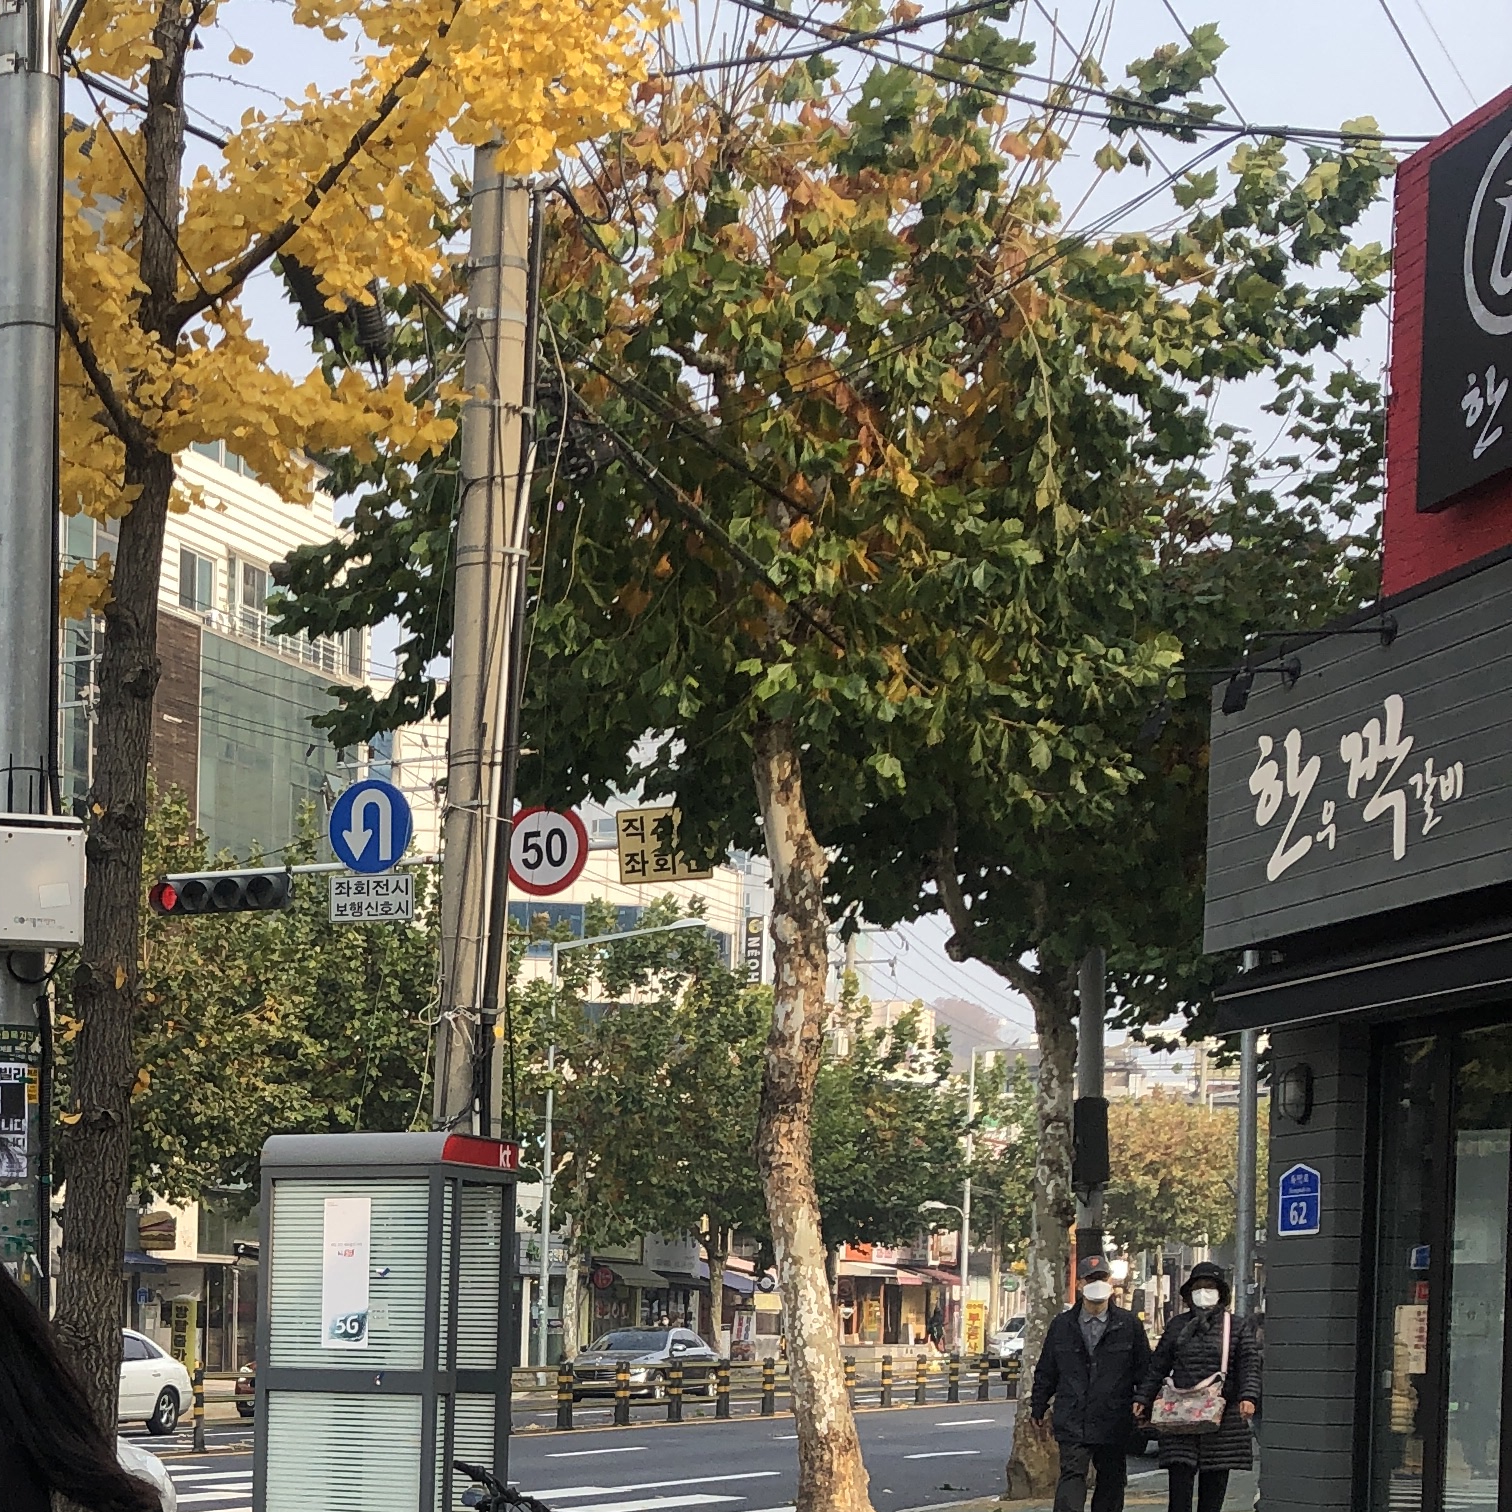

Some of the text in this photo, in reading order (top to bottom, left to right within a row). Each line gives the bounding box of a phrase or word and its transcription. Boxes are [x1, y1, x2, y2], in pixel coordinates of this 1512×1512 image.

[521, 827, 568, 871] 50
[334, 878, 408, 897] 좌회전시
[334, 899, 408, 917] 보행신호시
[499, 1145, 512, 1169] kt
[1289, 1201, 1308, 1226] 62
[334, 1314, 360, 1335] 5G
